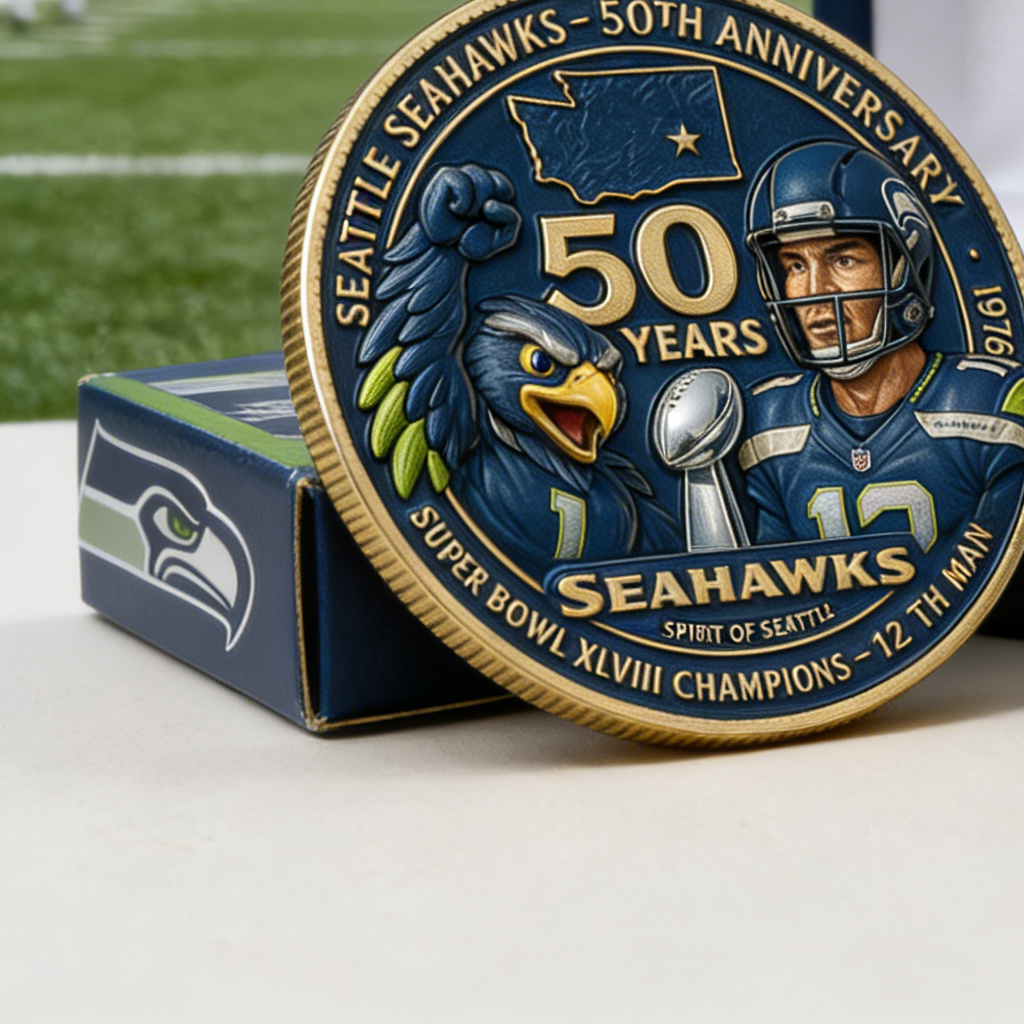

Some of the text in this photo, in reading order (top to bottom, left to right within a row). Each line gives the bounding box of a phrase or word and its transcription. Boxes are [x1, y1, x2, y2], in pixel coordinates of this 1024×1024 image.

[336, 147, 401, 326] SEATTLE
[384, 9, 567, 148] SEAHAWKS
[600, 0, 703, 41] 50TH
[715, 15, 964, 206] ANNIVERSARY
[540, 204, 738, 326] 50
[620, 319, 768, 364] YEARS
[973, 285, 1014, 356] 1976
[409, 506, 489, 596] SUPER
[486, 582, 566, 658] BOWL
[573, 637, 663, 695] XLVIII
[673, 652, 852, 702] CHAMPIONS
[906, 584, 951, 627] TH
[942, 522, 993, 592] MAN
[558, 547, 916, 618] SEAHAWKS
[729, 623, 755, 643] OF
